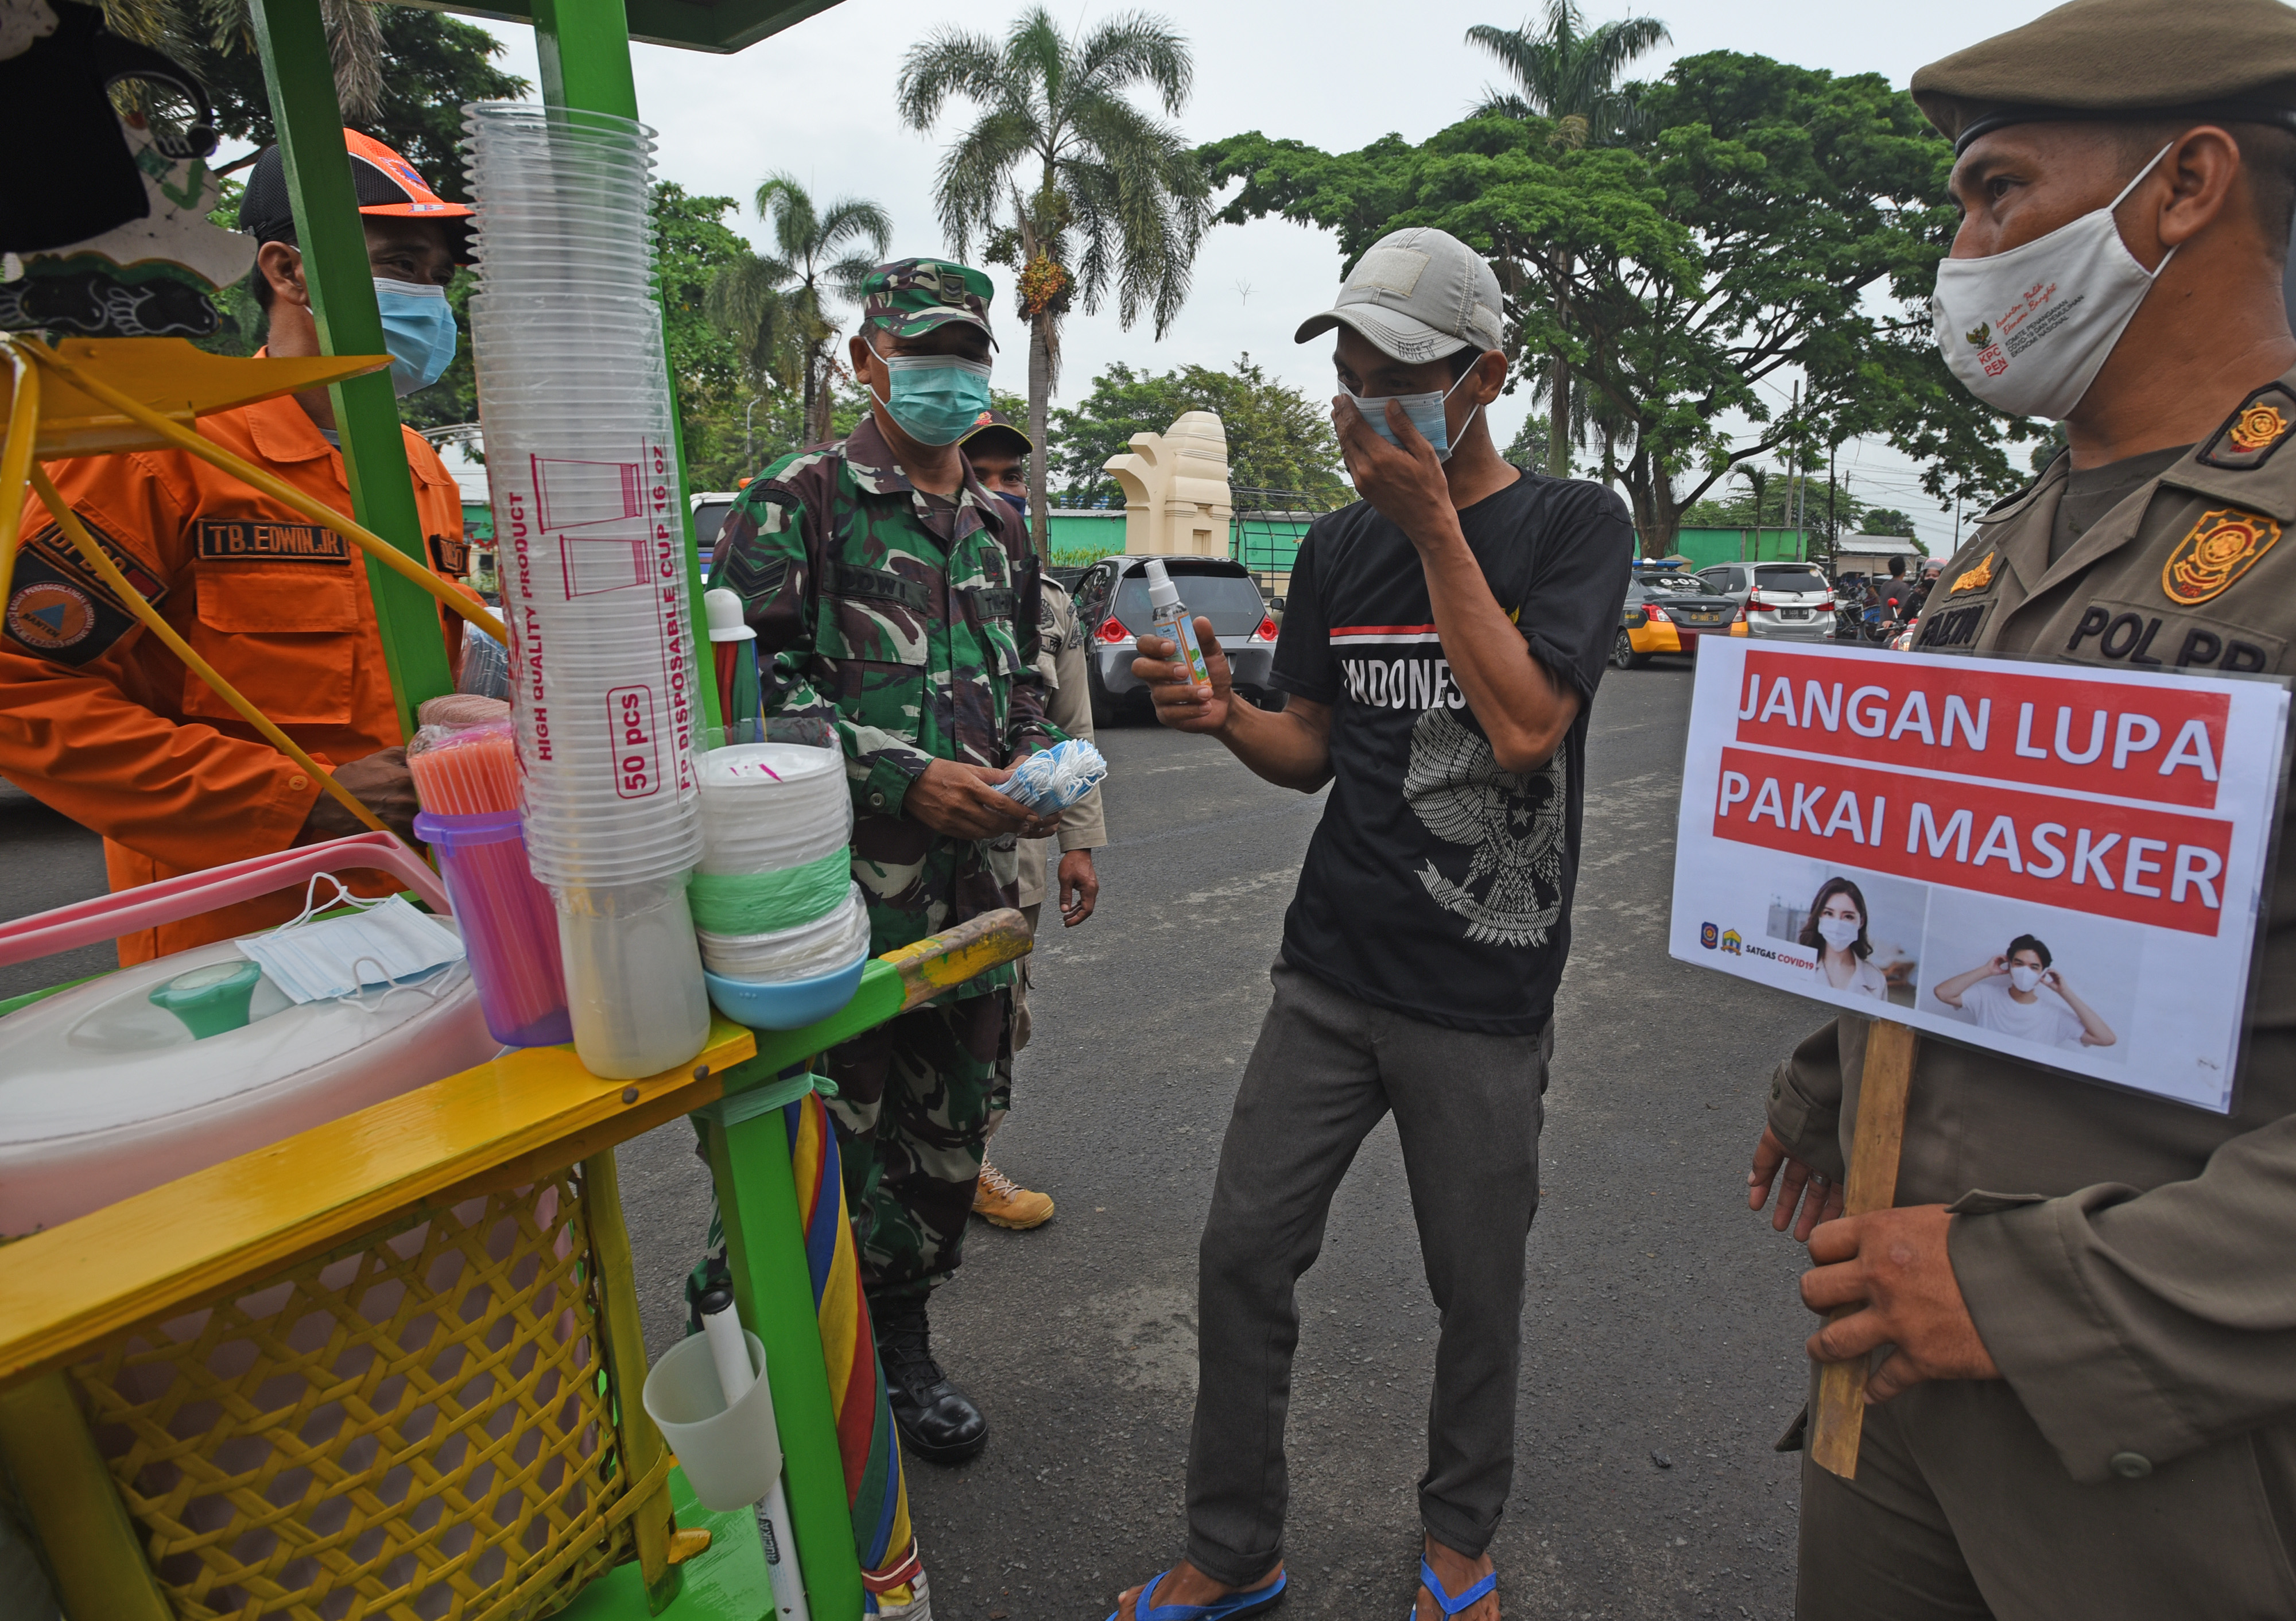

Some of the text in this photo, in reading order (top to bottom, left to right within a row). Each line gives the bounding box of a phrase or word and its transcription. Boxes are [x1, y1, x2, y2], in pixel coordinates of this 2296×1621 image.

[2005, 299, 2068, 347] KOMITE PENANGANAN
[2007, 294, 2084, 352] COVID-19 DAN PEMULIHAN
[2010, 316, 2069, 358] EKONOMI NASIONAL
[1979, 347, 2002, 365] KPC
[1984, 357, 2007, 374] PEN
[651, 485, 666, 515] 16
[656, 523, 674, 578] CUP
[509, 492, 553, 761] HIGH QUALITY PRODUCT
[2068, 606, 2162, 665] POL
[664, 586, 691, 750] DISPOSABLE
[622, 693, 649, 790] 50 pcs
[1739, 674, 2219, 782] JANGAN LUPA
[1719, 770, 2223, 909] PAKAI MASKER
[1746, 944, 1814, 970] SATGAS COVID19
